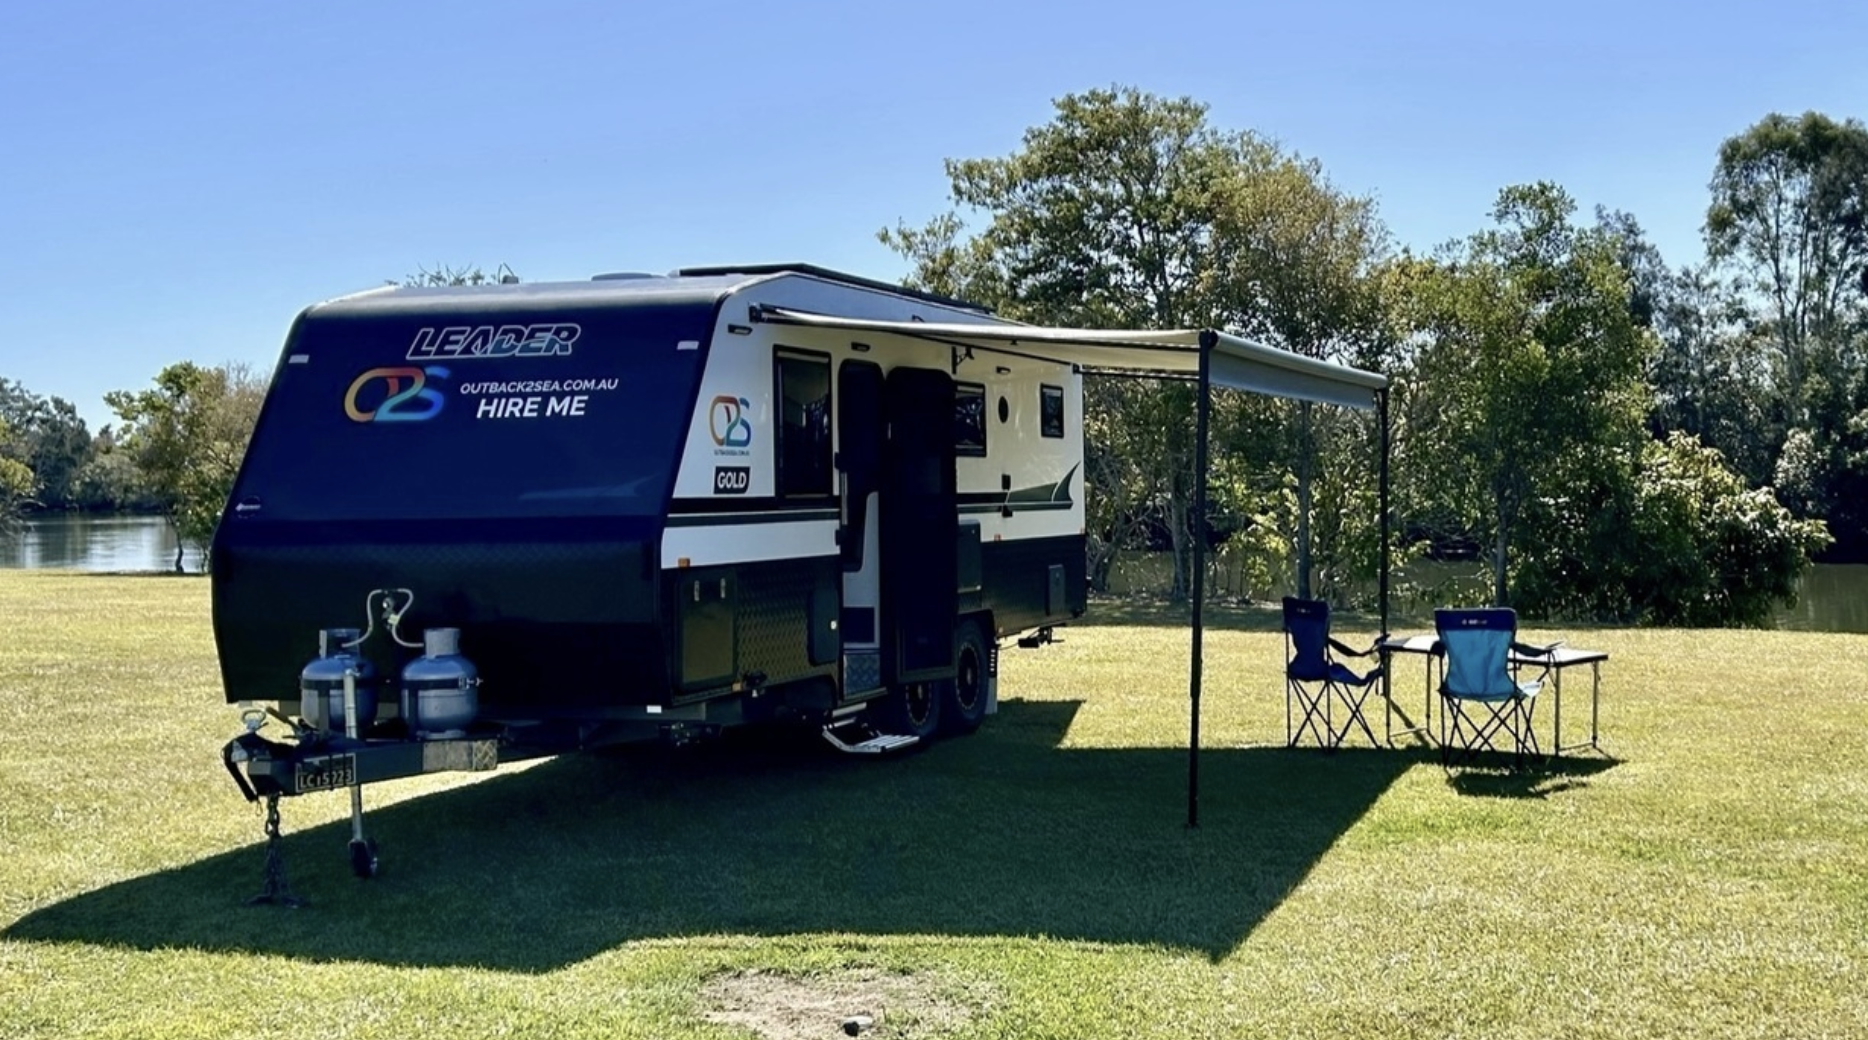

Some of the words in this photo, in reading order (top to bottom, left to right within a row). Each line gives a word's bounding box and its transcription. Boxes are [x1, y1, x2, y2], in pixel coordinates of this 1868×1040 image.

[406, 323, 581, 360] LEADER
[460, 378, 619, 394] OUTBACK2SEA.COM.AU
[476, 397, 541, 419] HIRE
[545, 396, 588, 417] ME
[717, 471, 747, 489] GOLD
